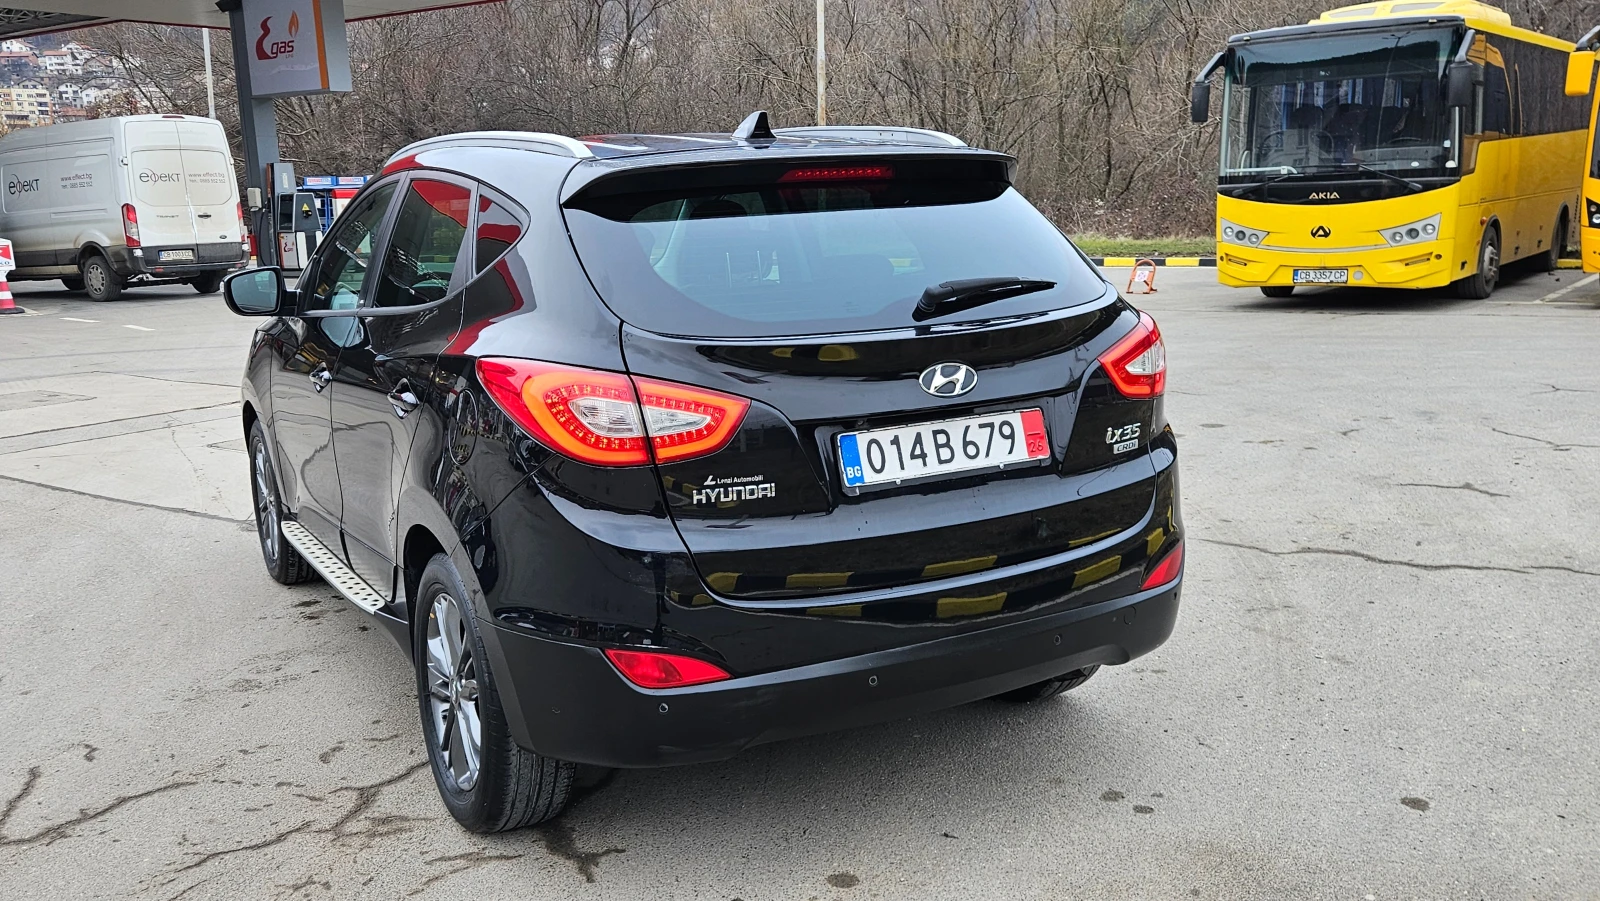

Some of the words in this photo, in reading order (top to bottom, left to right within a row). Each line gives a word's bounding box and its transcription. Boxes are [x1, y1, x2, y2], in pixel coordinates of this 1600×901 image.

[1312, 271, 1332, 279] 3357
[1106, 423, 1141, 444] ix35
[1117, 441, 1137, 451] CRDi
[846, 466, 862, 478] BG
[1028, 440, 1044, 452] 26
[733, 475, 763, 483] Automobili
[692, 483, 776, 504] HYUNDAI
